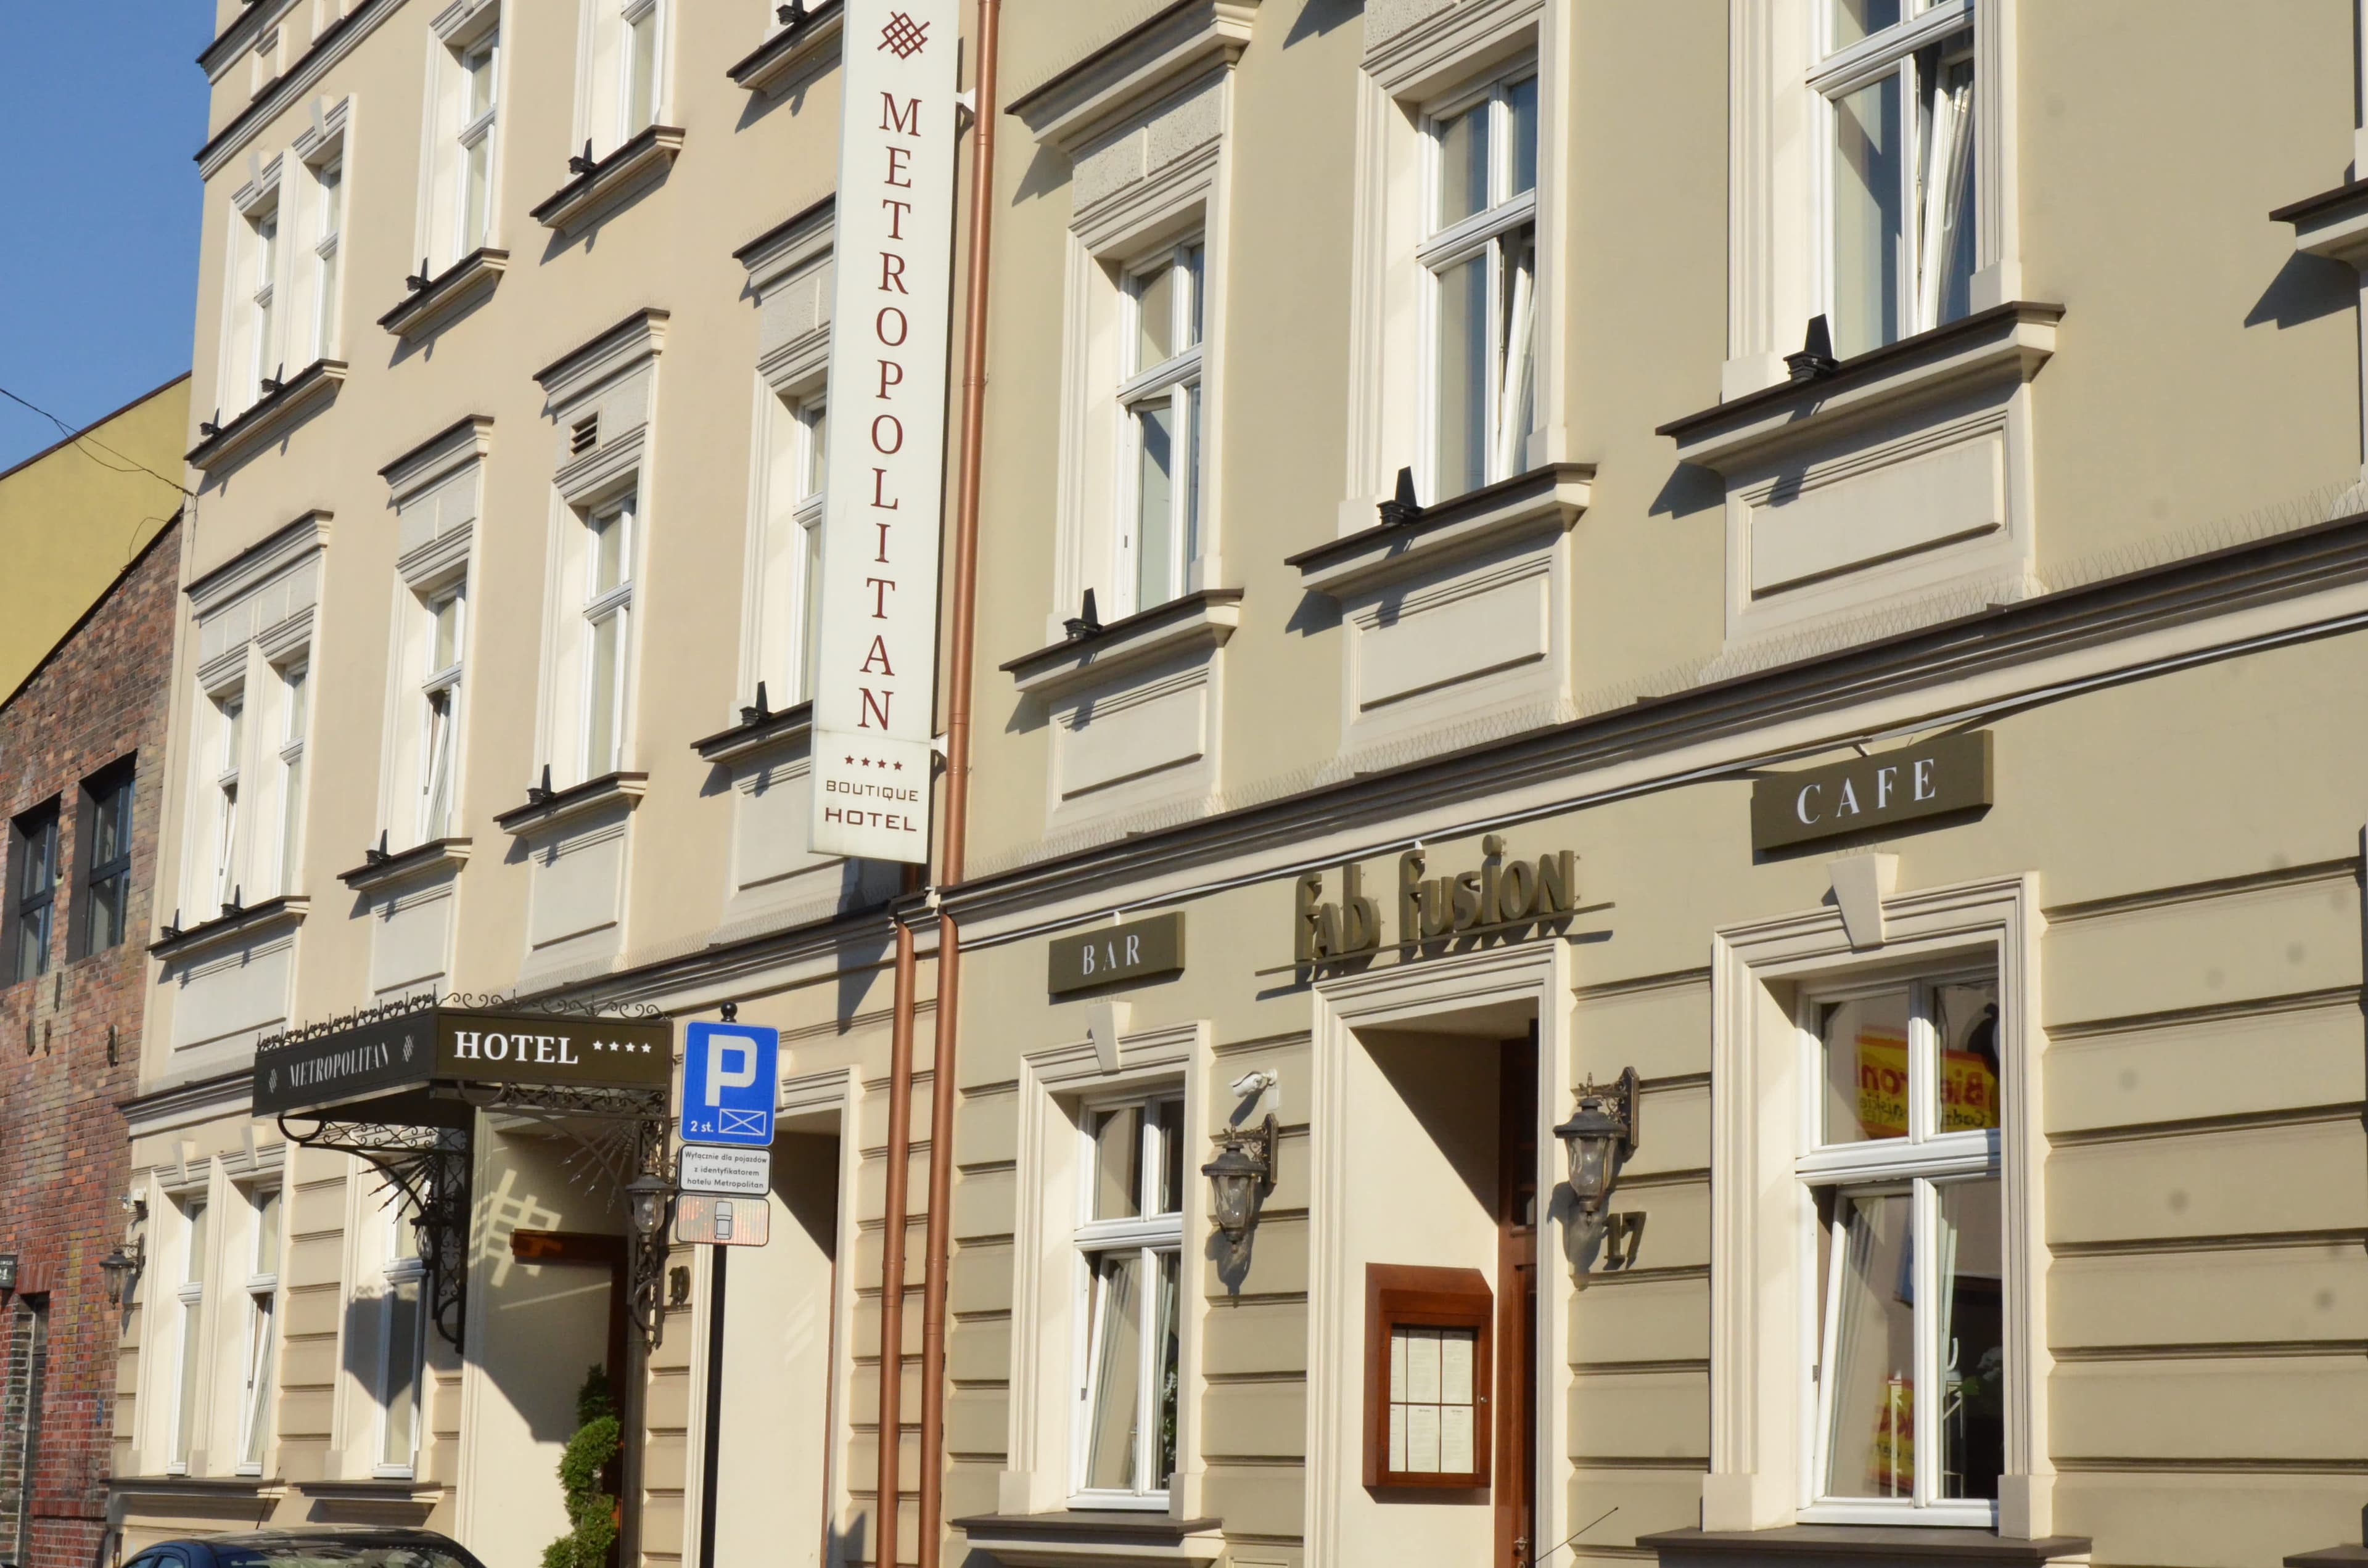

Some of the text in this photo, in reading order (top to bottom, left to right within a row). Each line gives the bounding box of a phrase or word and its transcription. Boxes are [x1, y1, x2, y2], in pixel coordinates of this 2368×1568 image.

[857, 91, 923, 731] METROPOLITAN
[826, 779, 919, 802] BOUTIQUE
[1796, 758, 1936, 825] CAFE
[824, 807, 918, 832] HOTEL
[1082, 934, 1140, 975] BAR
[454, 1031, 578, 1064] HOTEL
[289, 1041, 389, 1089] METROPOLITAN
[705, 1033, 758, 1107] P
[690, 1120, 714, 1133] 2 st.
[685, 1151, 719, 1161] Wyłącznie
[734, 1155, 767, 1164] pojazdów
[701, 1166, 760, 1176] identyfikatorem
[714, 1178, 763, 1189] Metropolitan
[1602, 1211, 1647, 1266] 17
